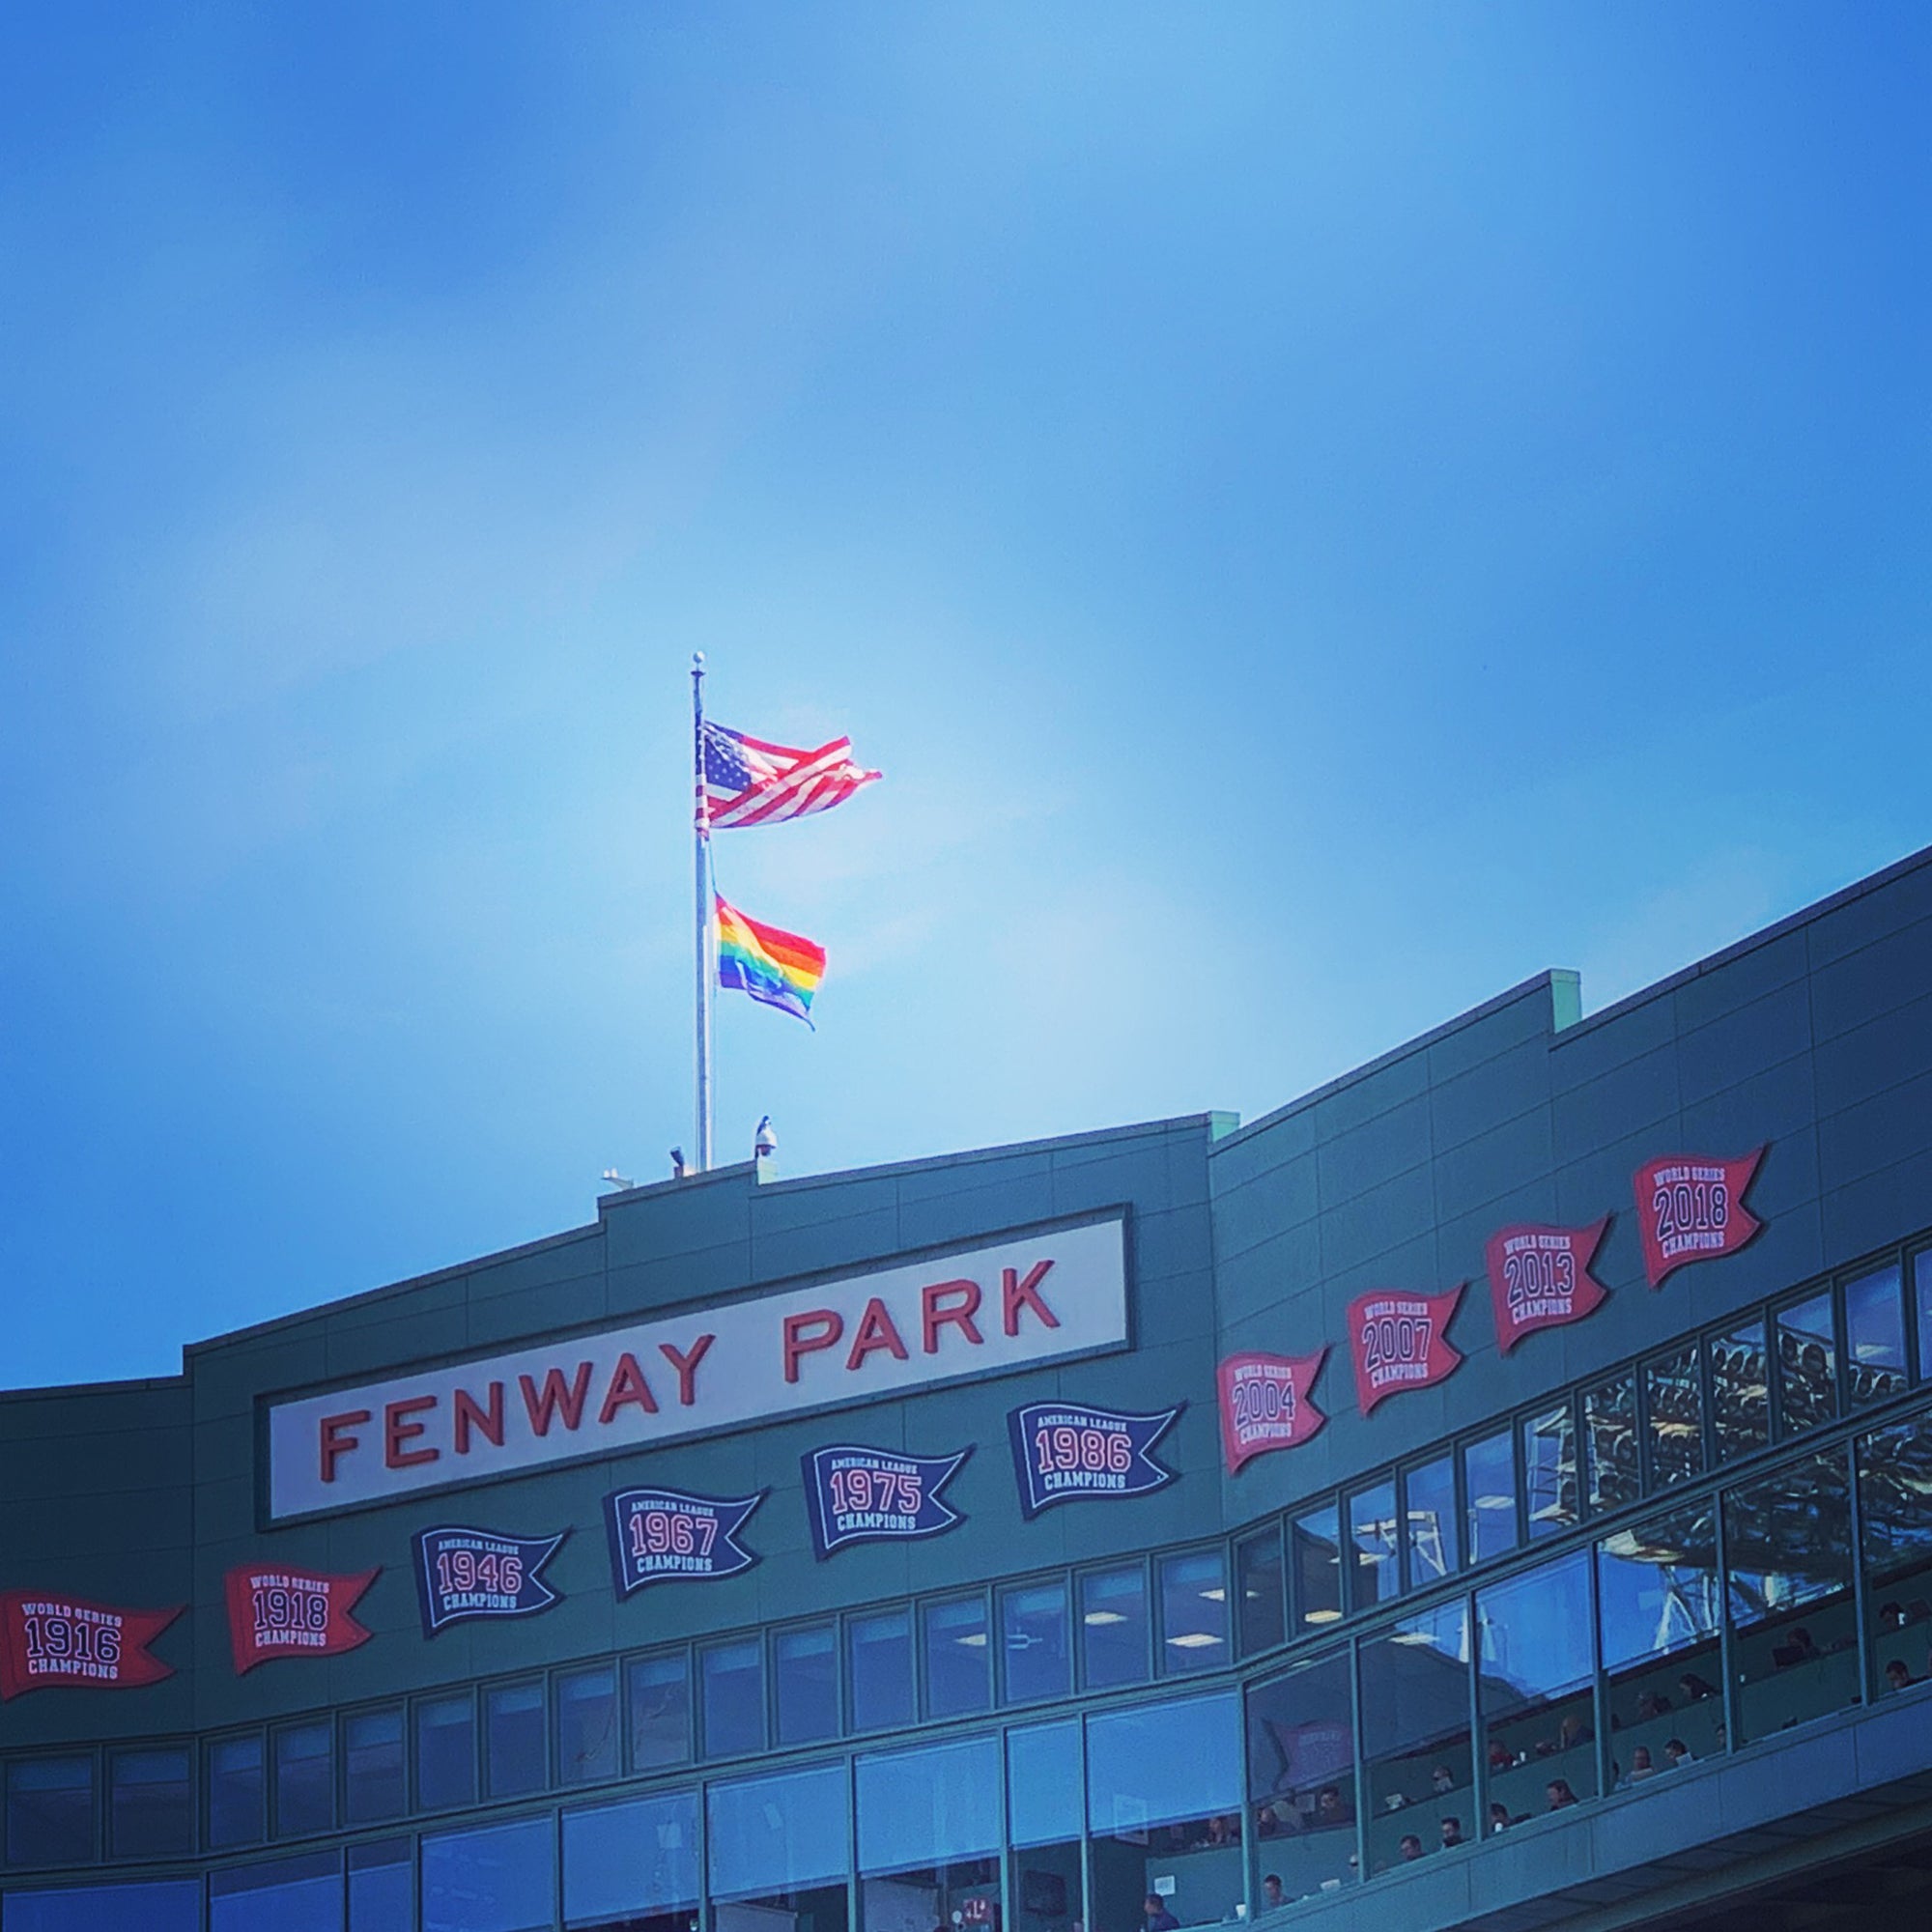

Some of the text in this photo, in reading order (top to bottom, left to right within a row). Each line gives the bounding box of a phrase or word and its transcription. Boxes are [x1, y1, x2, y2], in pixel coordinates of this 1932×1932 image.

[1654, 1166, 1690, 1187] WORLD
[1653, 1183, 1728, 1241] 2018
[1662, 1232, 1724, 1258] CHAMPIONS
[1504, 1251, 1576, 1309] 2013
[1512, 1297, 1573, 1324] CHAMPIONS
[1361, 1317, 1432, 1373] 2007
[320, 1259, 1061, 1484] FENWAY PARK
[1232, 1379, 1296, 1431] 2004
[1037, 1414, 1126, 1433] AMERICAN LEAGUE
[1035, 1427, 1132, 1474] 1986
[831, 1457, 918, 1474] AMERICAN LEAGUE
[830, 1469, 922, 1515] 1975
[1044, 1471, 1126, 1491] CHAMPIONS
[631, 1499, 678, 1513] AMERICAN
[629, 1512, 719, 1557] 1967
[837, 1512, 916, 1531] CHAMPIONS
[437, 1550, 523, 1595] 1946
[637, 1554, 713, 1574] CHAMPIONS
[250, 1574, 289, 1589] WORLD
[22, 1603, 71, 1617] WORLD
[252, 1589, 328, 1631] 1918
[442, 1592, 518, 1611] CHAMPIONS
[24, 1616, 122, 1664] 1916
[255, 1629, 327, 1648] CHAMPIONS
[28, 1658, 118, 1680] CHAMPIONS
